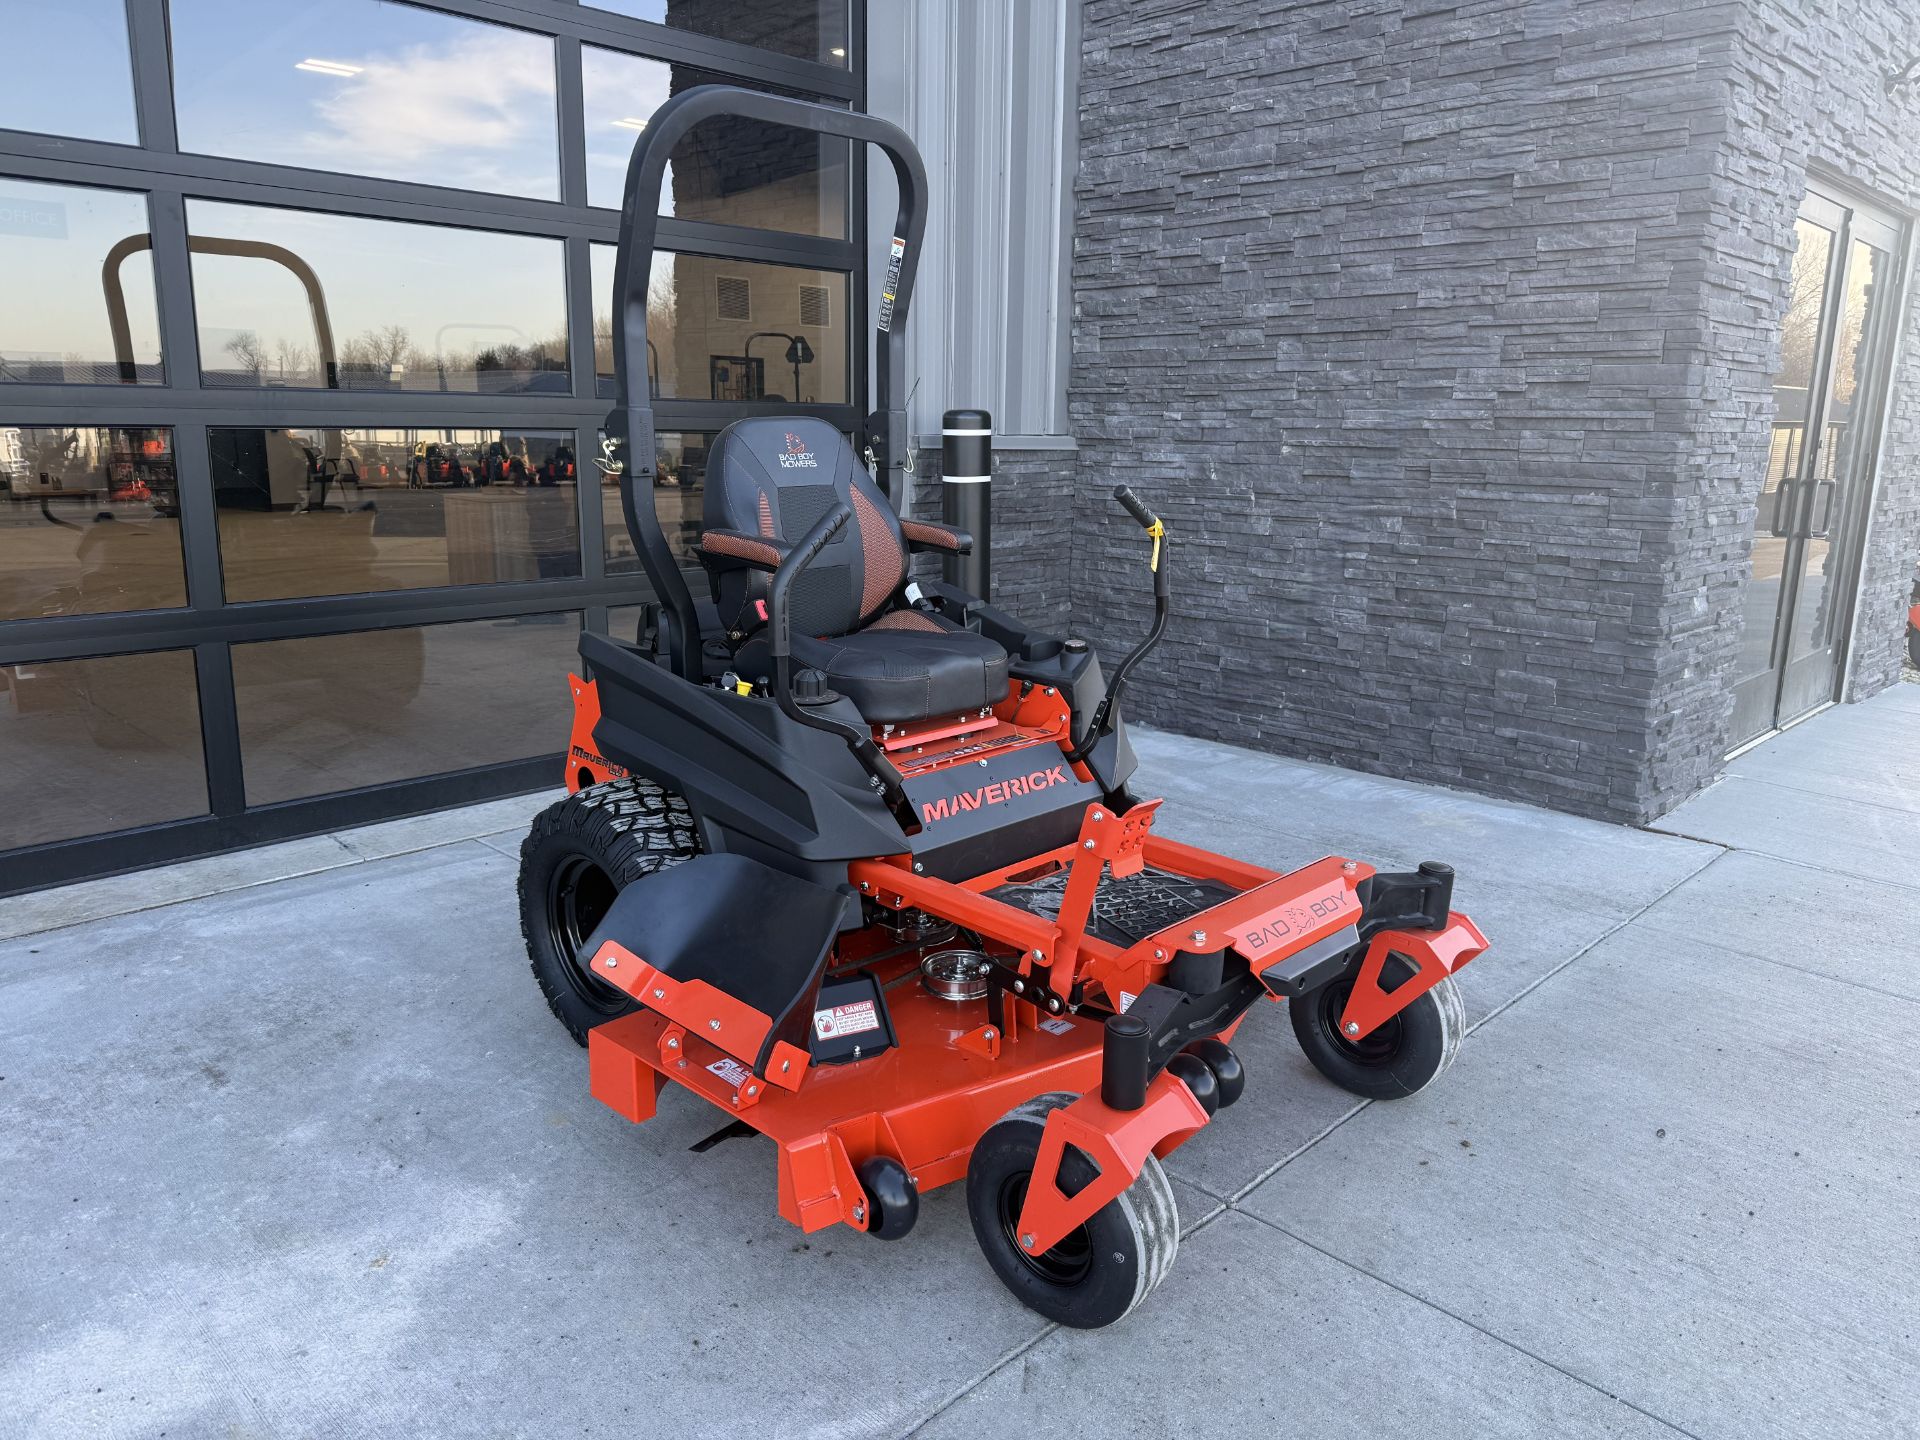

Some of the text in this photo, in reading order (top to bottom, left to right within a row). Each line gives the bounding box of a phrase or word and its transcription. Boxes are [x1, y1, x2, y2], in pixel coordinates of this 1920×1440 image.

[778, 452, 814, 461] BAD BOY
[780, 459, 818, 468] MOWERS
[922, 764, 1068, 824] MAVERICK
[1245, 890, 1348, 949] BAD BOY
[844, 1002, 872, 1014] DANGER
